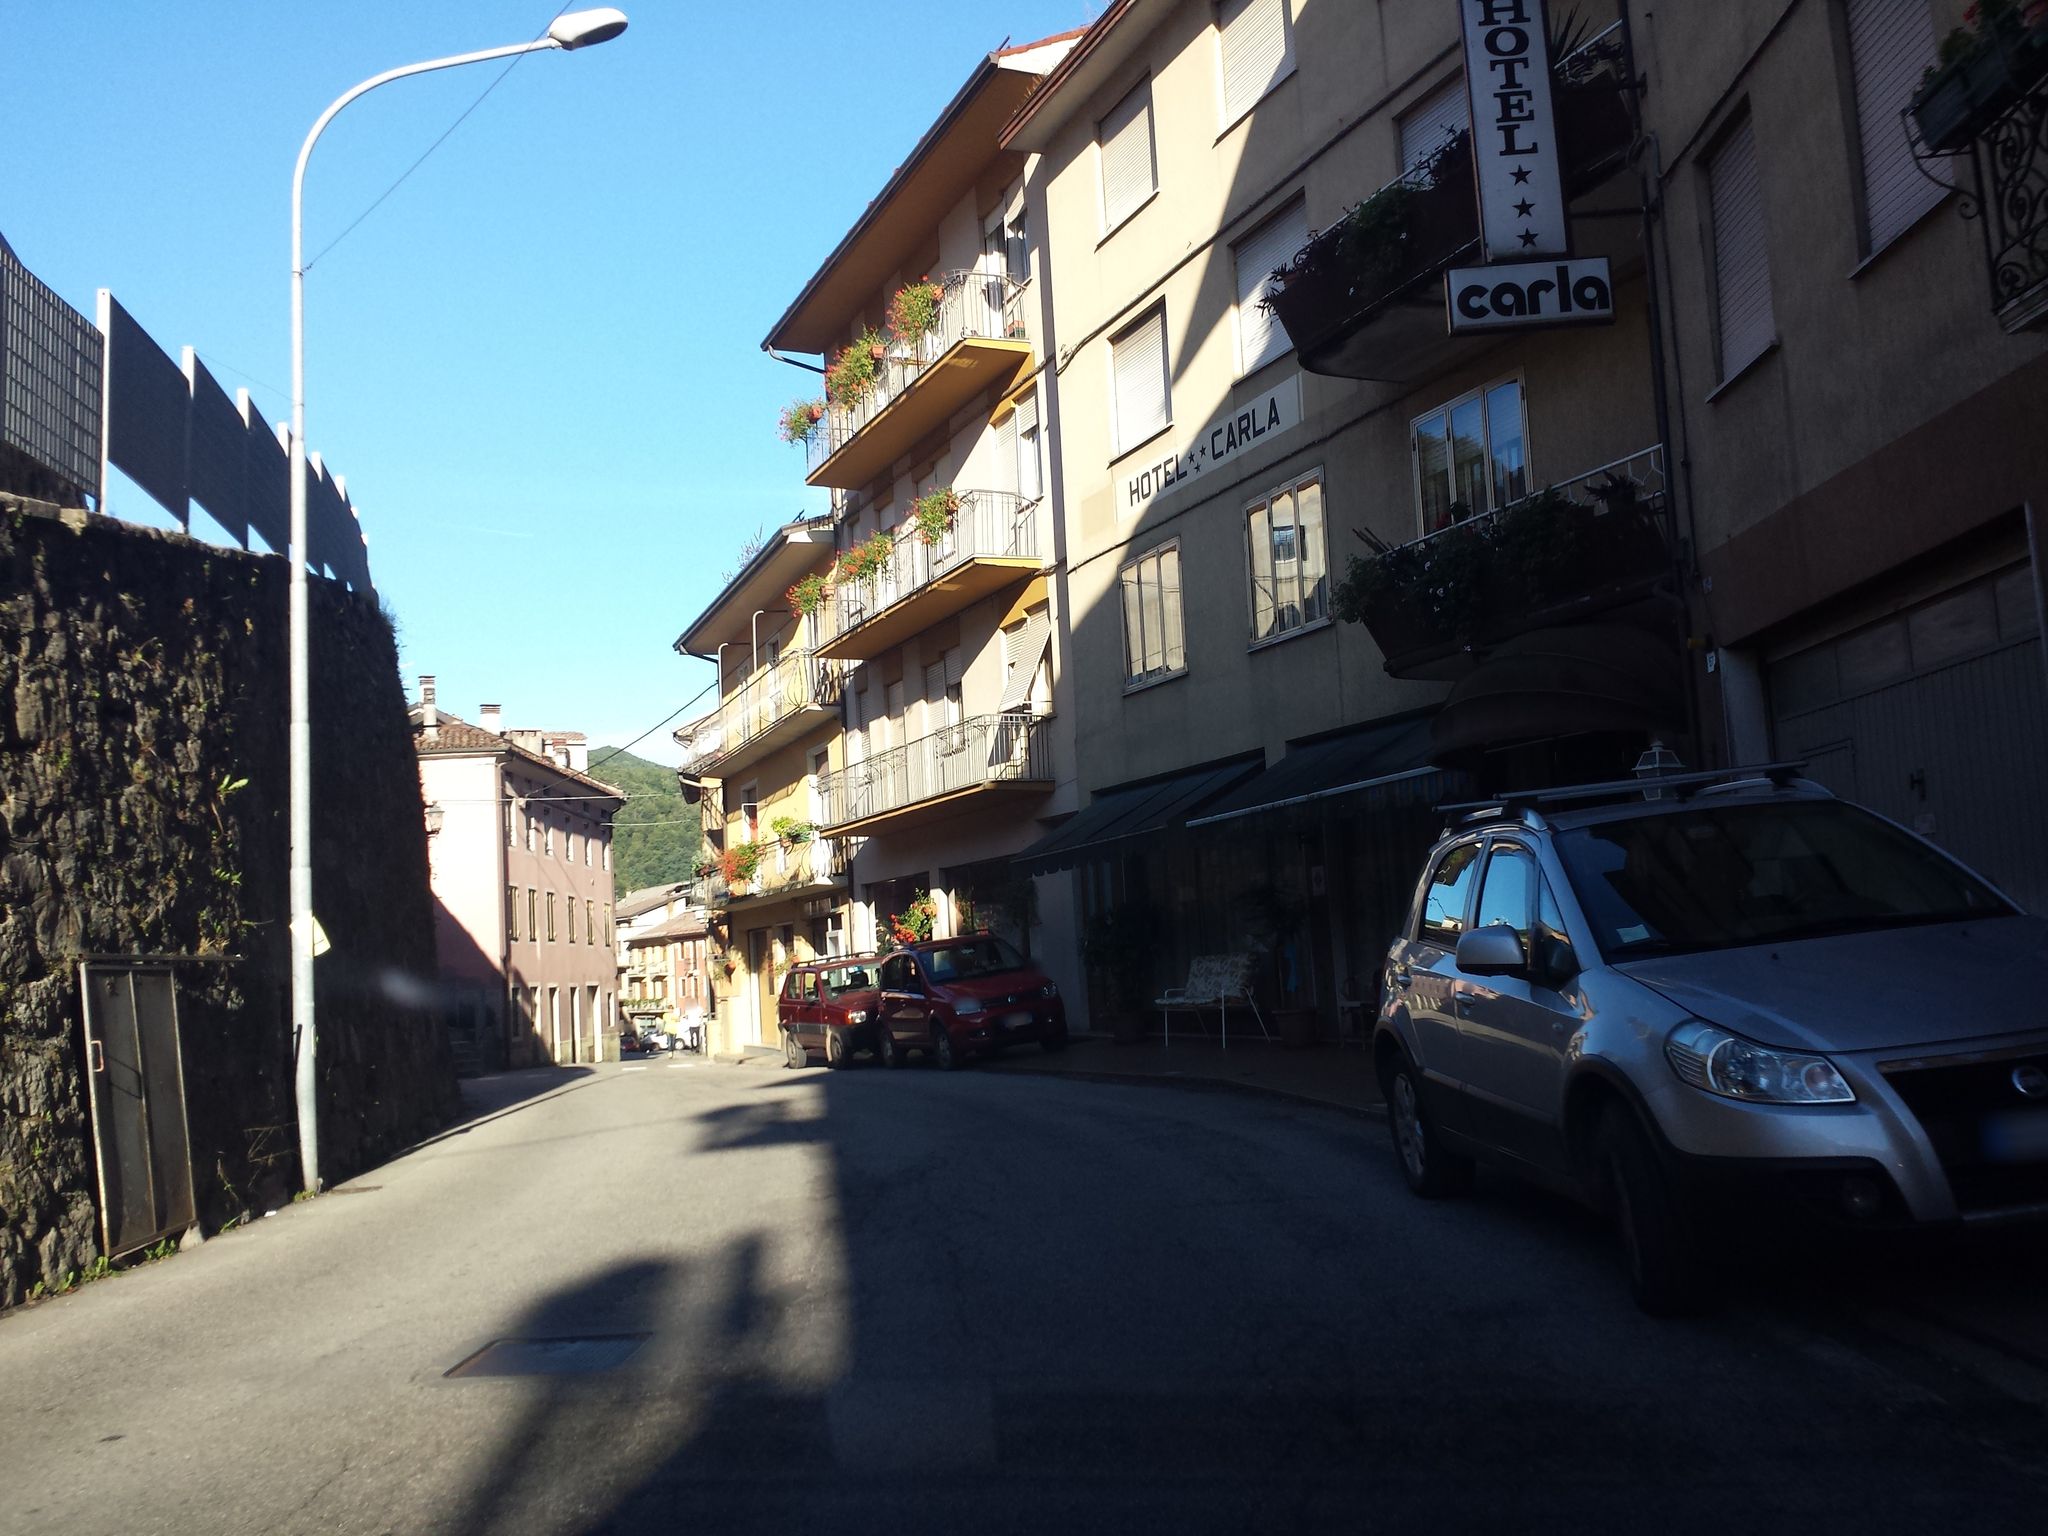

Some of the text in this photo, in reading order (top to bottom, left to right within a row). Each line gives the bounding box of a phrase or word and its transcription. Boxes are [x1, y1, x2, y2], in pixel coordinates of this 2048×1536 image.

[1477, 0, 1538, 156] HOTEL
[1457, 265, 1611, 320] carla
[1129, 397, 1281, 507] HOTEL CARLA
